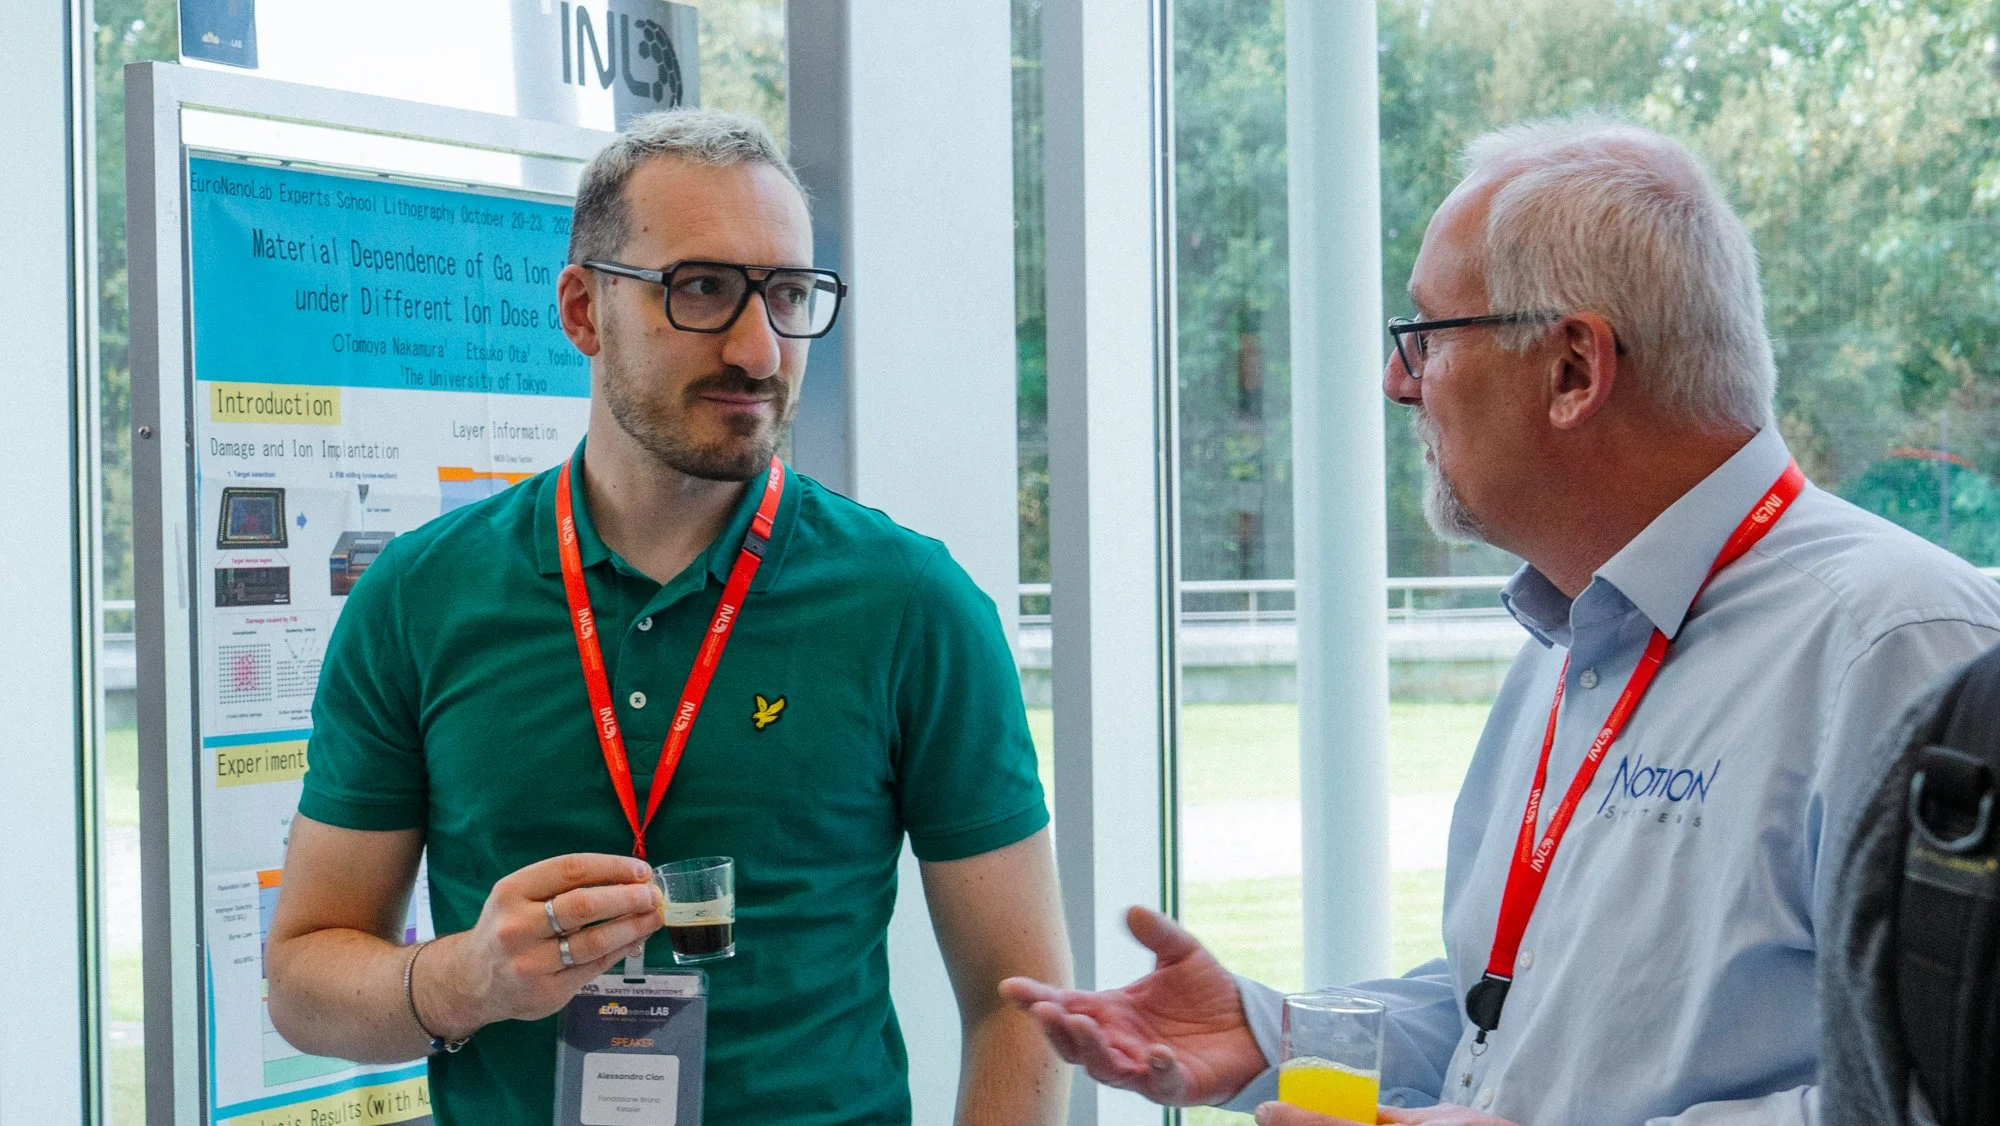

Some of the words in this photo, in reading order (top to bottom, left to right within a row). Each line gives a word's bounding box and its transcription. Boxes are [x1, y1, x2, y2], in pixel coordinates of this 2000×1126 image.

[191, 172, 272, 200] EuroNanoLab
[280, 183, 330, 207] Experts
[337, 190, 377, 213] School
[384, 196, 455, 225] Lithography
[460, 205, 504, 227] October
[553, 216, 570, 236] 202
[252, 228, 338, 265] Material
[351, 239, 456, 276] Dependence
[465, 252, 483, 279] of
[493, 254, 513, 282] Ga
[523, 257, 550, 285] Ion
[295, 284, 348, 313] under
[361, 287, 452, 322] Different
[464, 296, 492, 325] Ion
[501, 299, 539, 328] Dose
[466, 342, 503, 362] Etsuko
[548, 348, 584, 368] Yoshio
[430, 368, 492, 391] University
[499, 372, 511, 391] of
[516, 373, 547, 394] Tokyo
[217, 388, 333, 416] Introduction
[452, 420, 485, 440] Layer
[493, 421, 558, 440] Information
[210, 437, 255, 460] Damage
[263, 440, 284, 457] and
[293, 439, 313, 458] Ion
[322, 439, 400, 461] Implantation
[611, 1037, 654, 1047] SPEAKER
[597, 1072, 643, 1081] Alessandro
[645, 1073, 665, 1081] Cian
[311, 1100, 362, 1126] Results
[367, 1089, 411, 1118] (with
